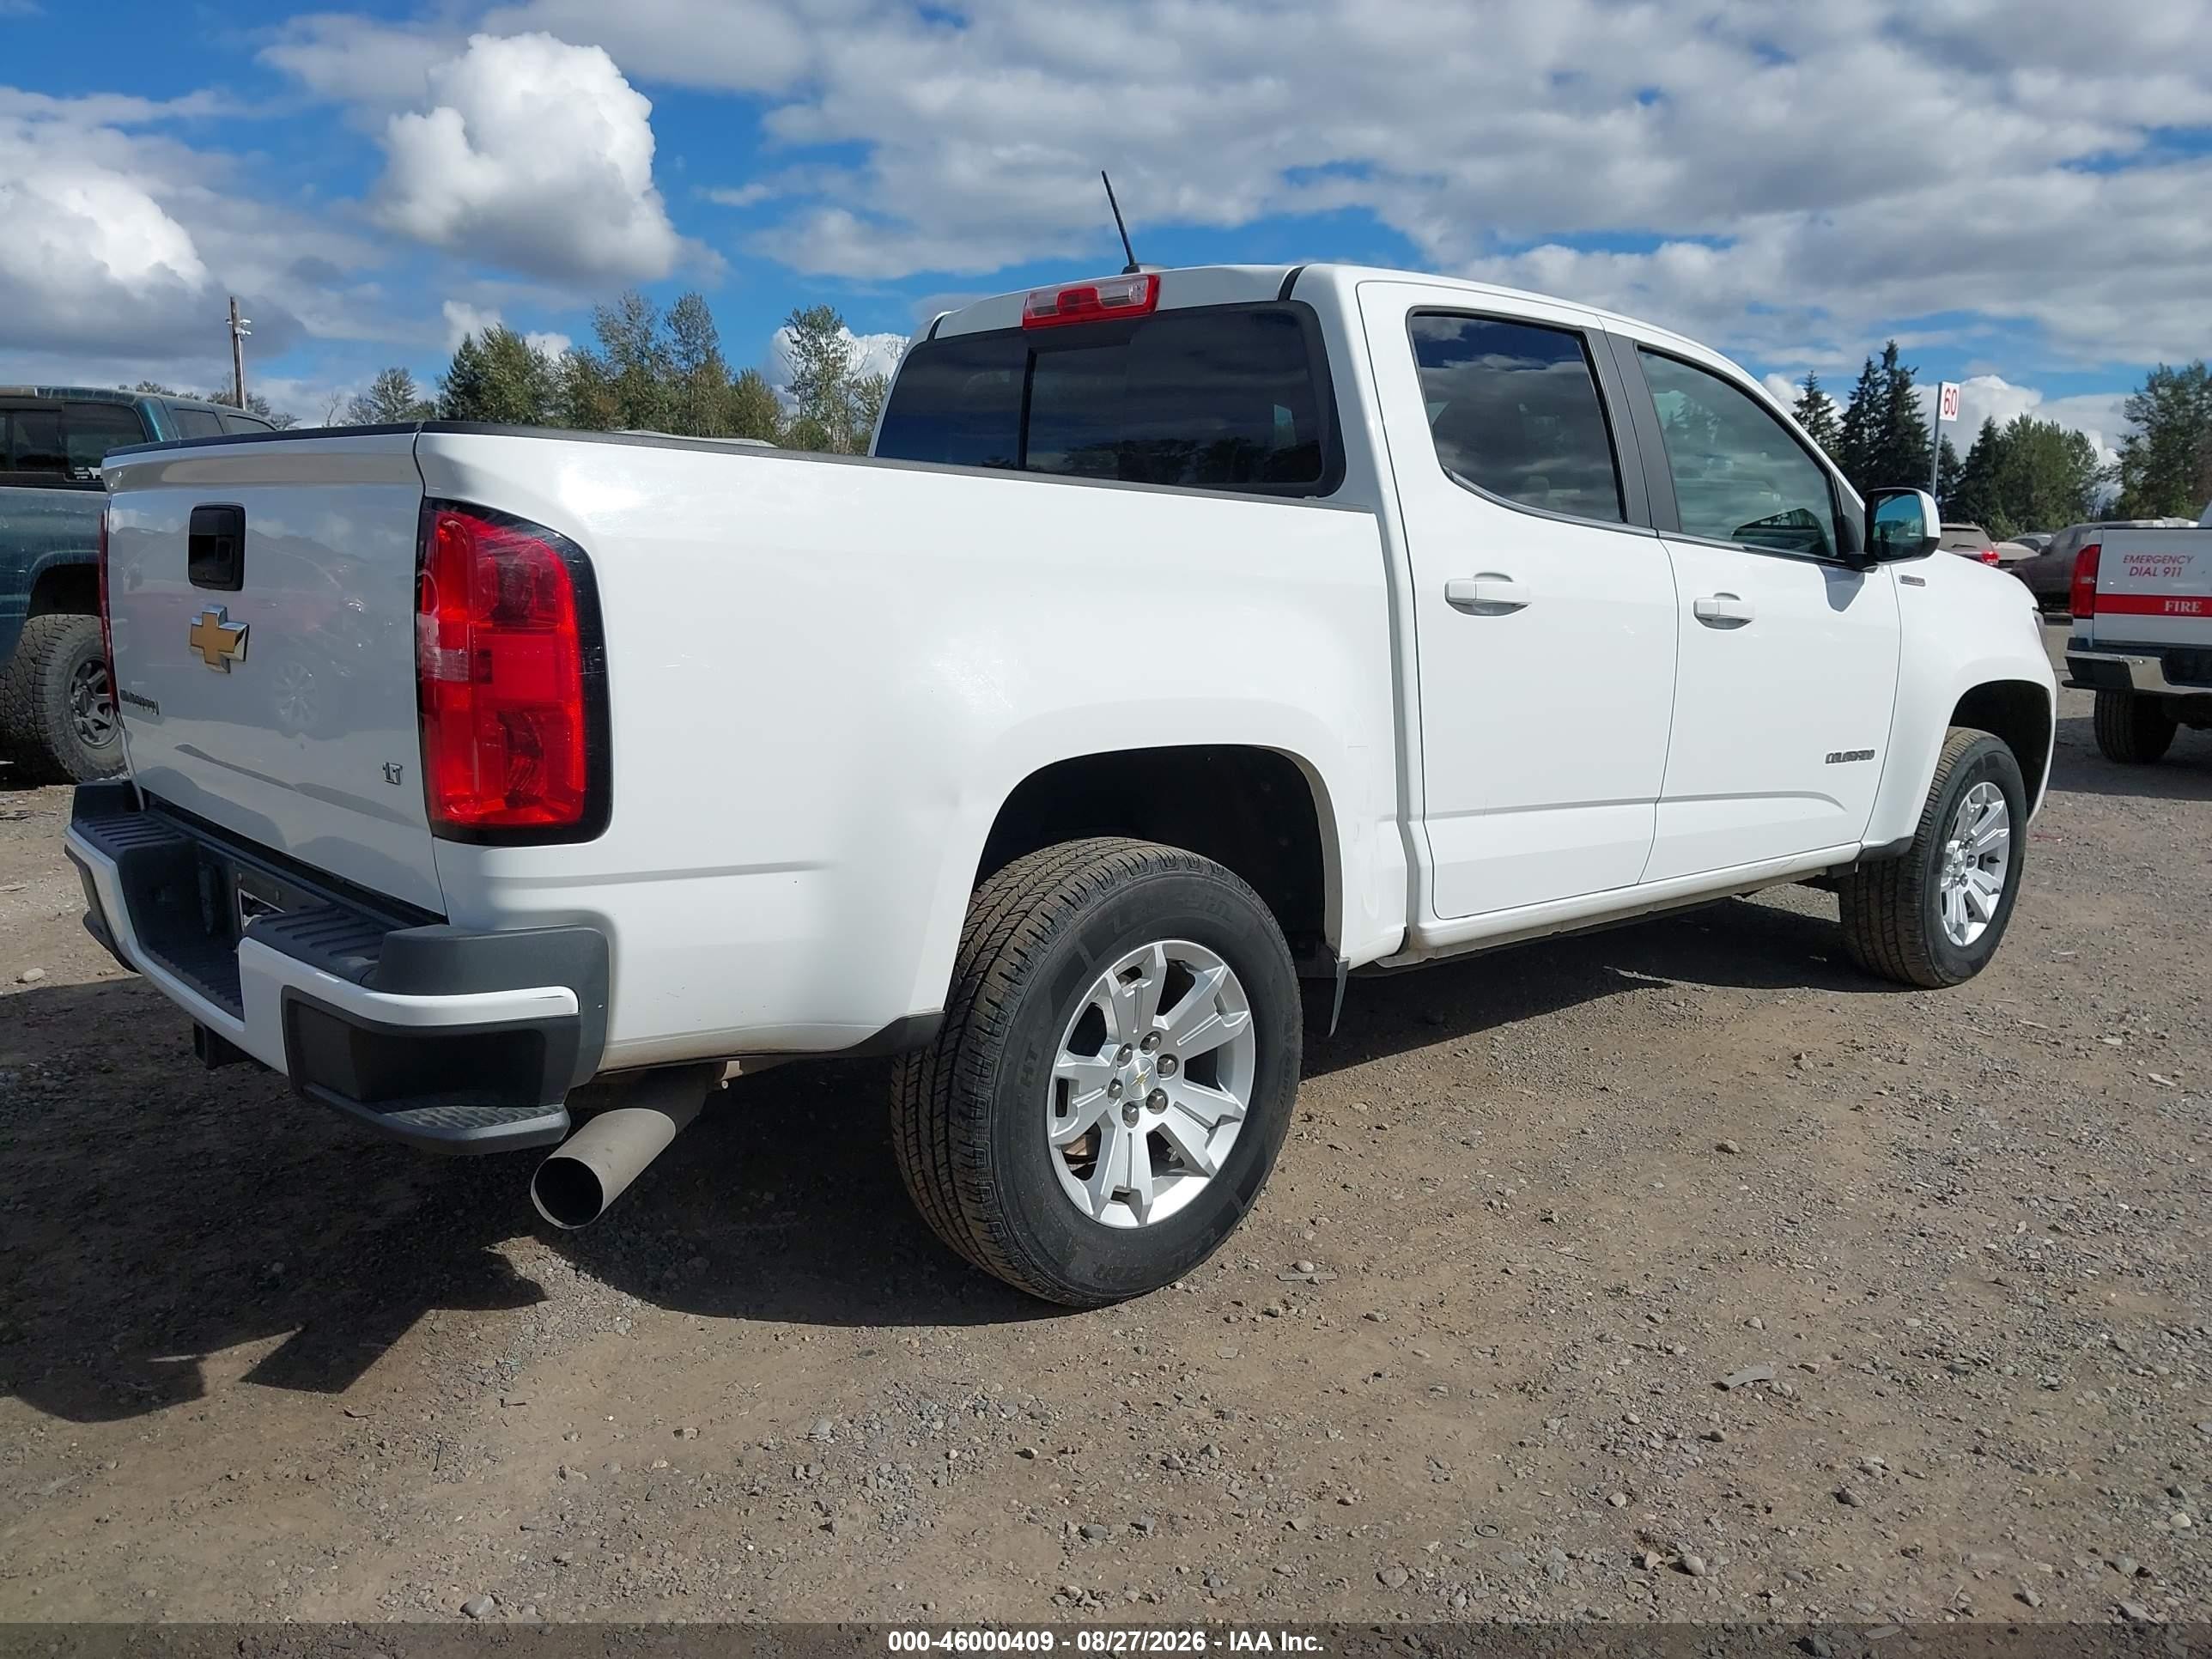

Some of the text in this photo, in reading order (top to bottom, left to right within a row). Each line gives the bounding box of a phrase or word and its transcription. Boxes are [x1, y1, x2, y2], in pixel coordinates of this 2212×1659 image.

[1944, 387, 1958, 416] 60
[2123, 555, 2195, 564] EMERGENCY
[2130, 567, 2182, 577] DIAL 911
[2165, 600, 2202, 612] FIRE
